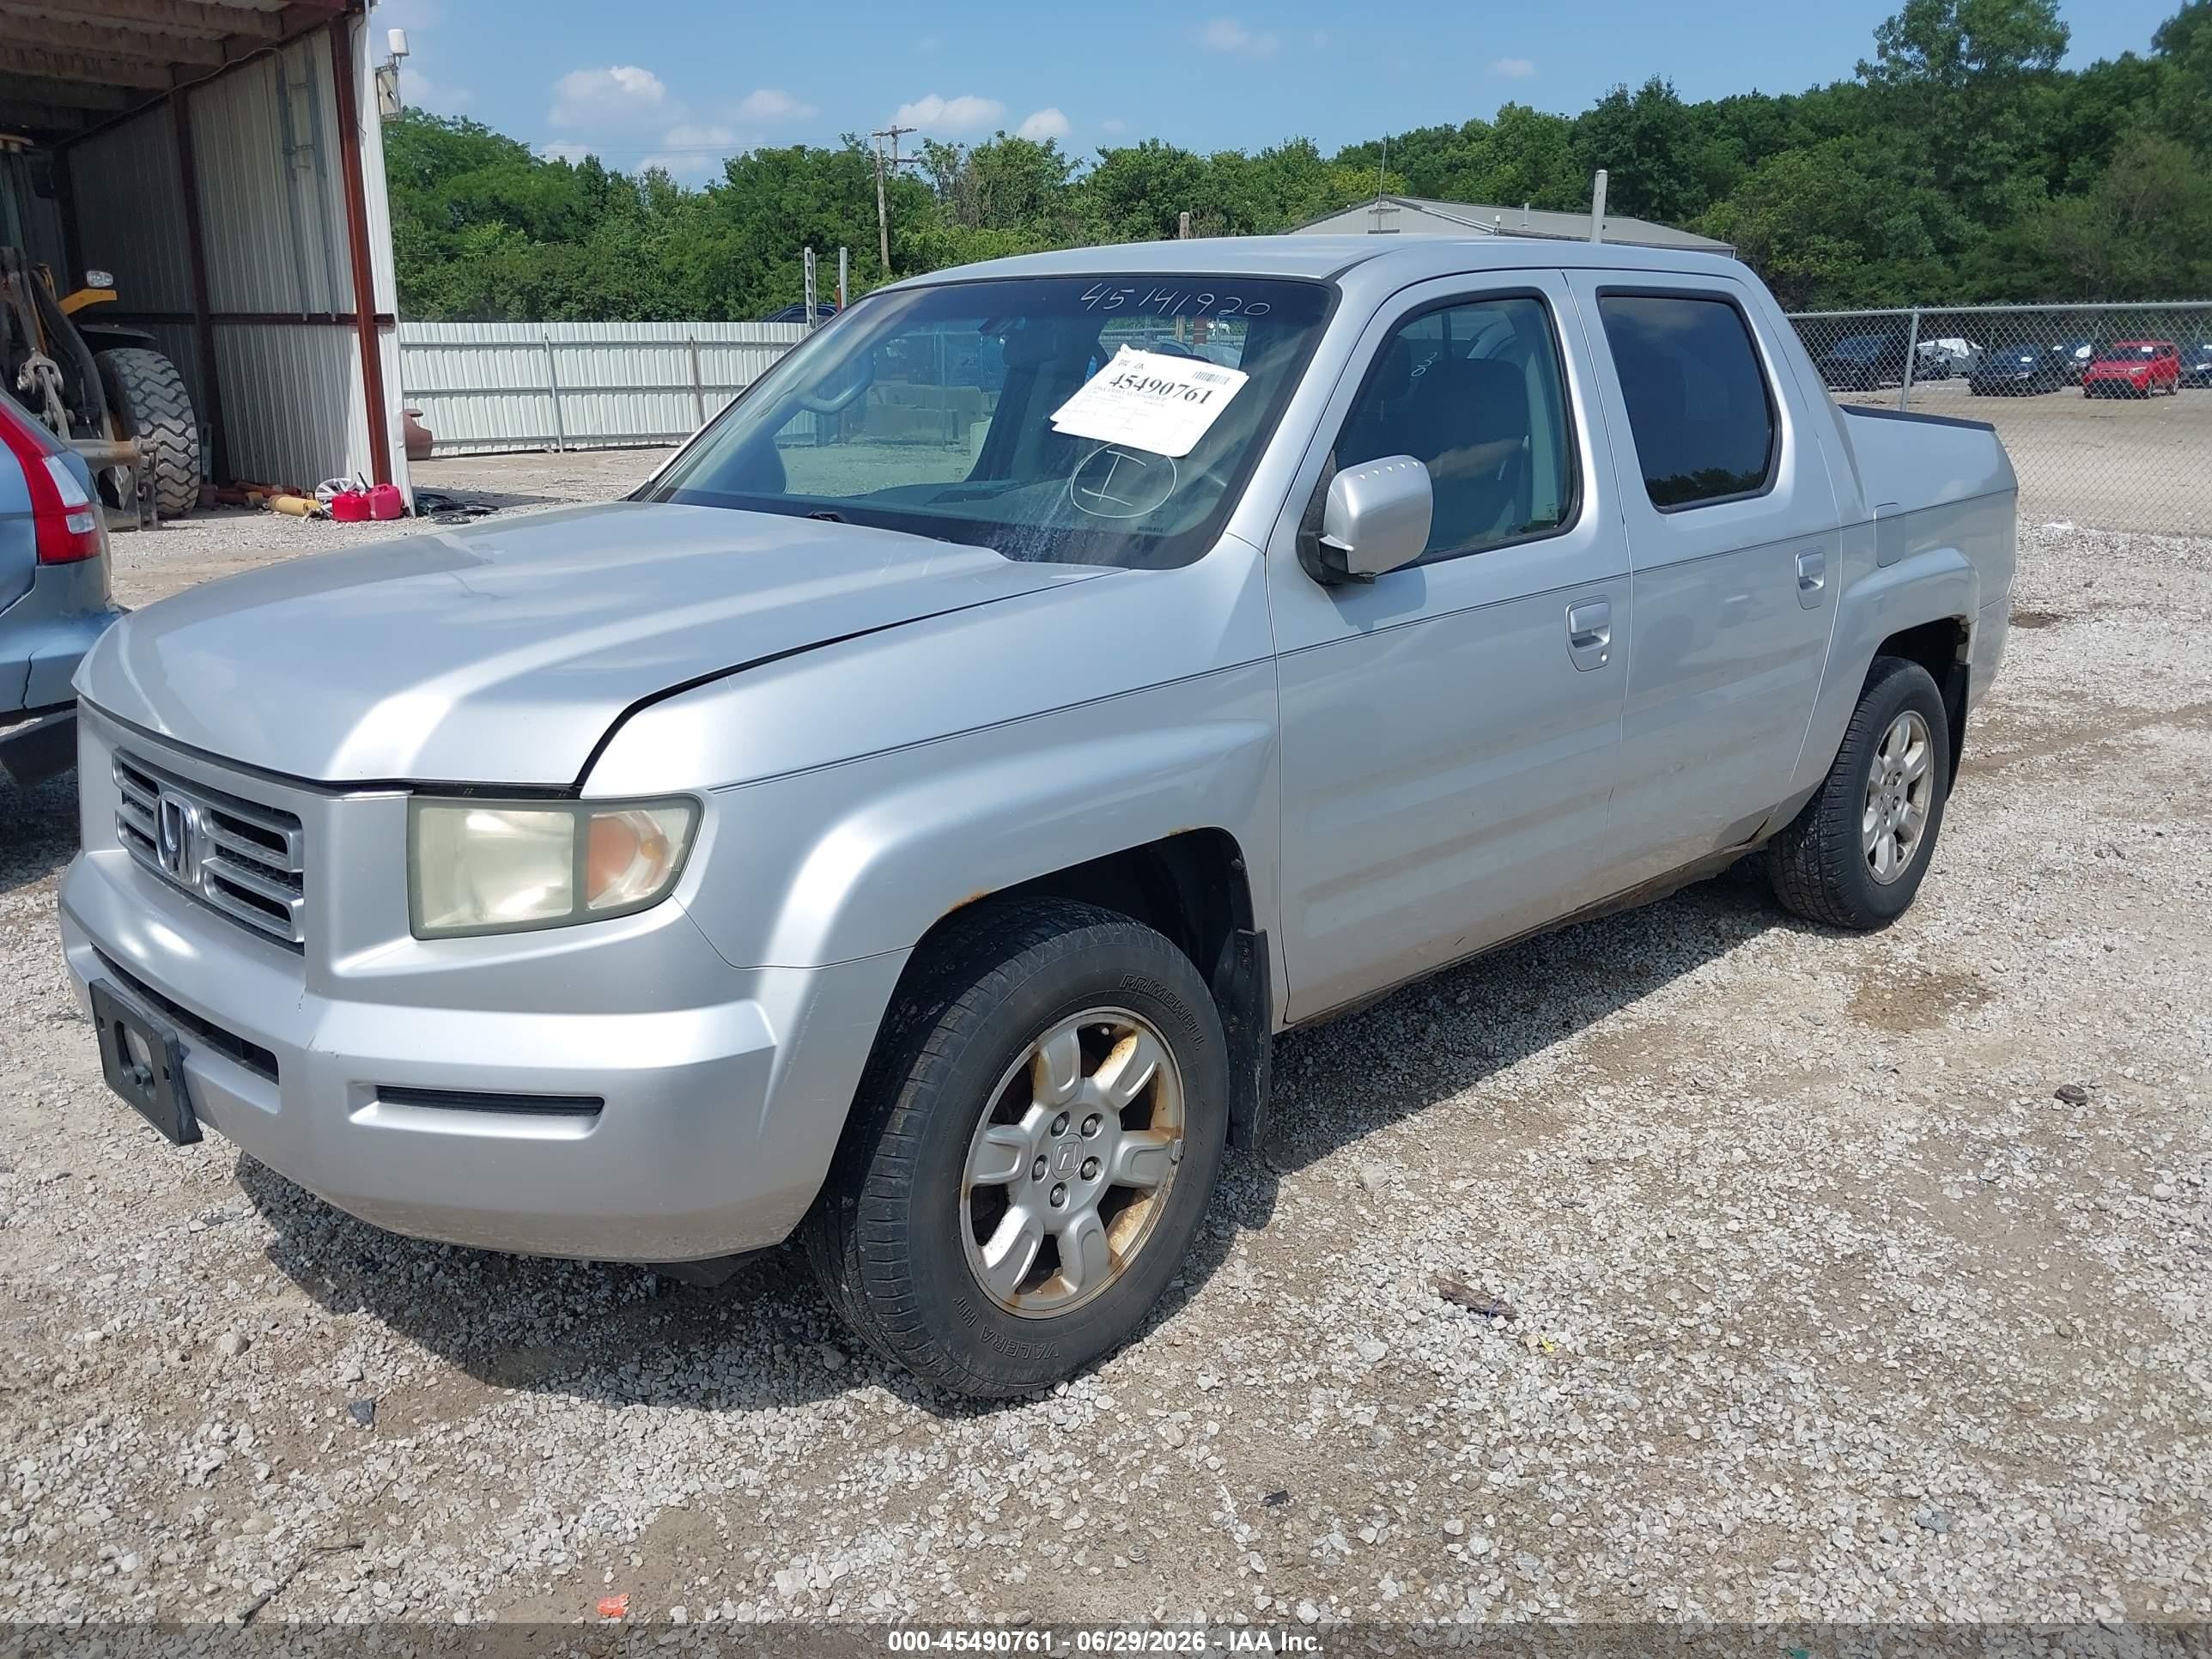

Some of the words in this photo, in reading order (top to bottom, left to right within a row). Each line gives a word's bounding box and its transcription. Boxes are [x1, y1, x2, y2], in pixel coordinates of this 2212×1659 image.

[1080, 283, 1271, 316] 45141920
[1109, 372, 1217, 404] 45490761
[1119, 973, 1205, 1051] PRIMEWELL
[979, 1324, 1060, 1360] VALERA
